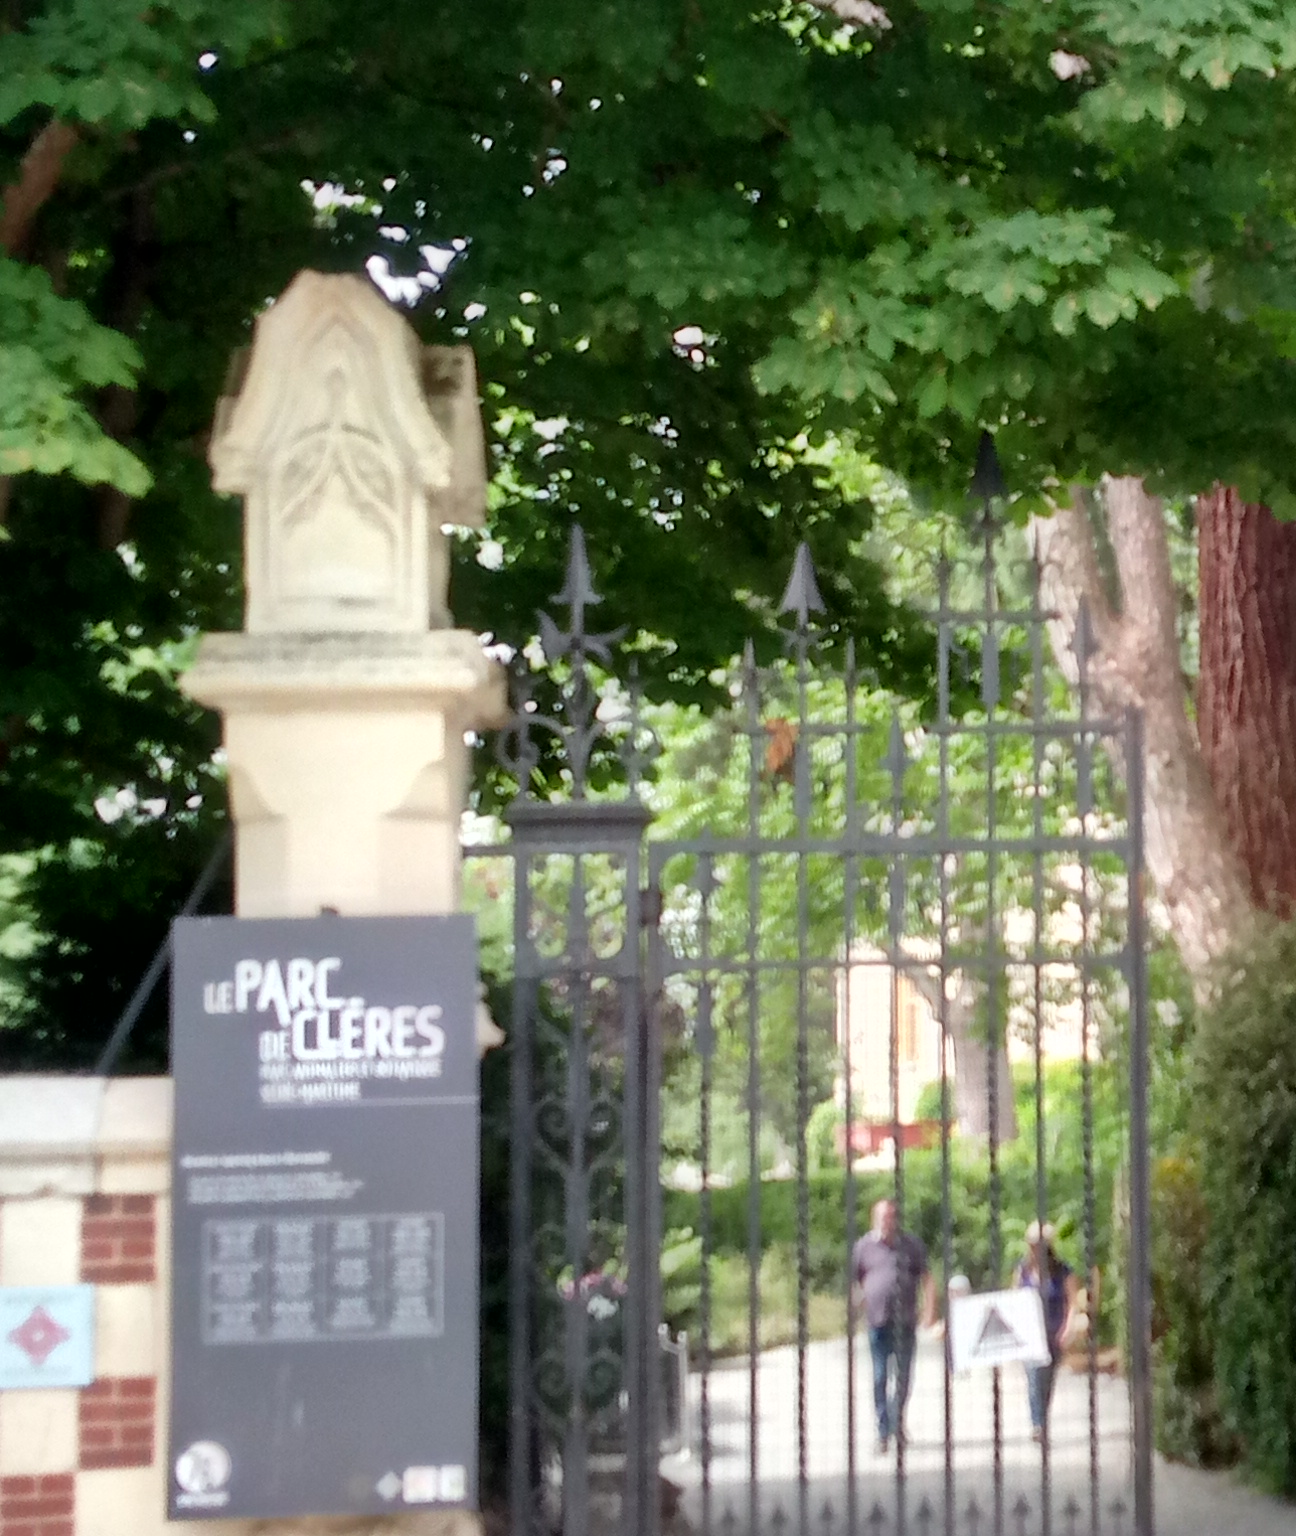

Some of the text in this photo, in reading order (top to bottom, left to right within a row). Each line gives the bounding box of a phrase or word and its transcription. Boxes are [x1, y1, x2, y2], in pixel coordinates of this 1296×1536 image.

[204, 957, 346, 1027] LE PARC
[259, 1030, 290, 1062] DE
